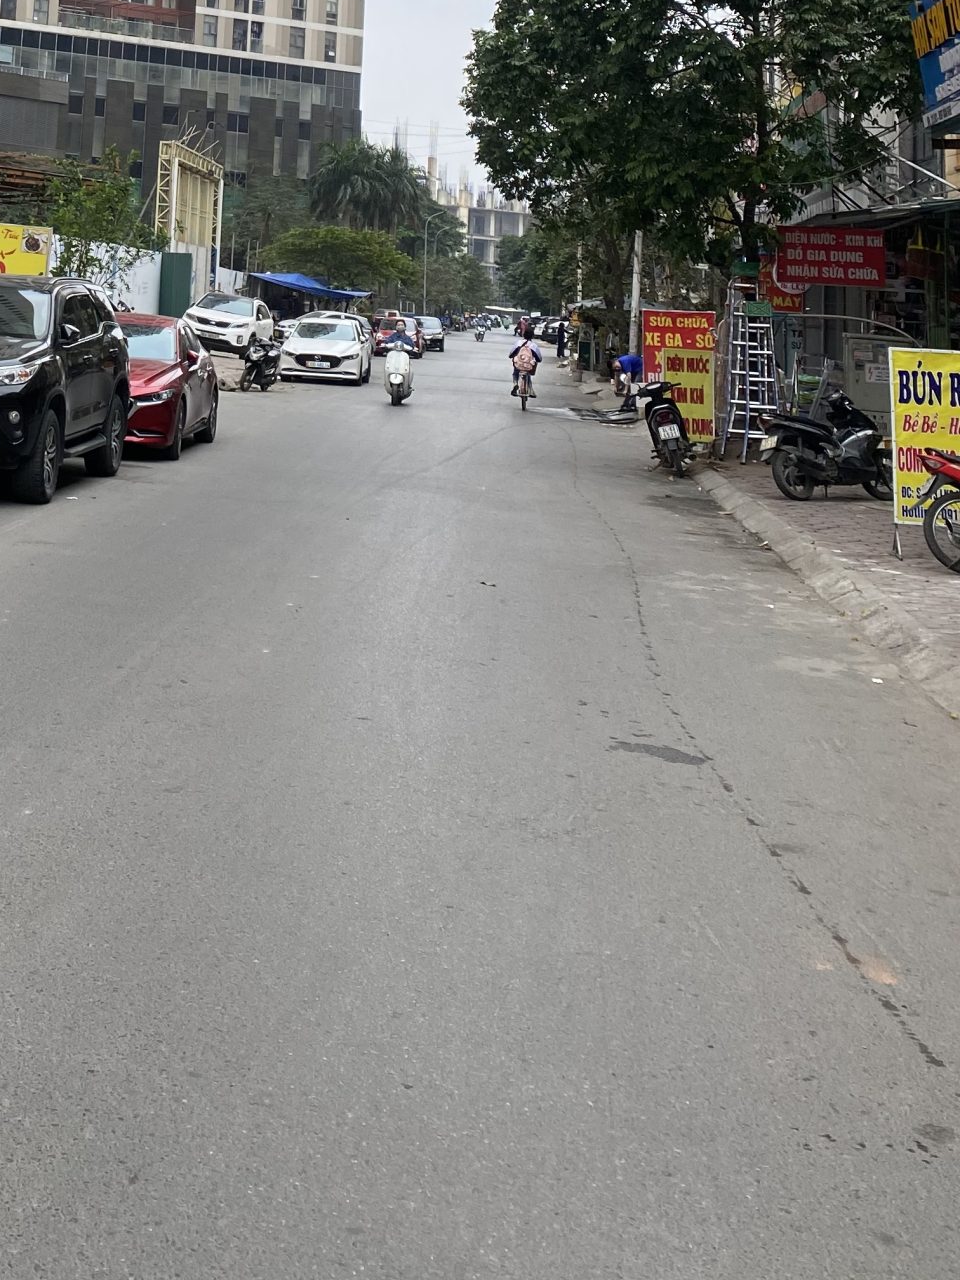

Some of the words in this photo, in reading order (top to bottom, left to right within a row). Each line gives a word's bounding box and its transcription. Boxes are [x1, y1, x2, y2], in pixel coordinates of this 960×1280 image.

[844, 234, 865, 247] KIM
[806, 249, 827, 262] GIA
[830, 250, 864, 265] DỤNG
[786, 264, 819, 280] NHẬN
[821, 263, 845, 279] SỬA
[847, 266, 880, 281] CHỮA
[649, 313, 673, 328] SỬA
[676, 315, 709, 329] CHỮA
[645, 331, 661, 347] XE
[665, 332, 683, 348] GA
[898, 360, 942, 406] BÚN
[689, 384, 705, 405] KHÍ
[903, 411, 920, 433] Bề
[921, 412, 939, 434] Bề
